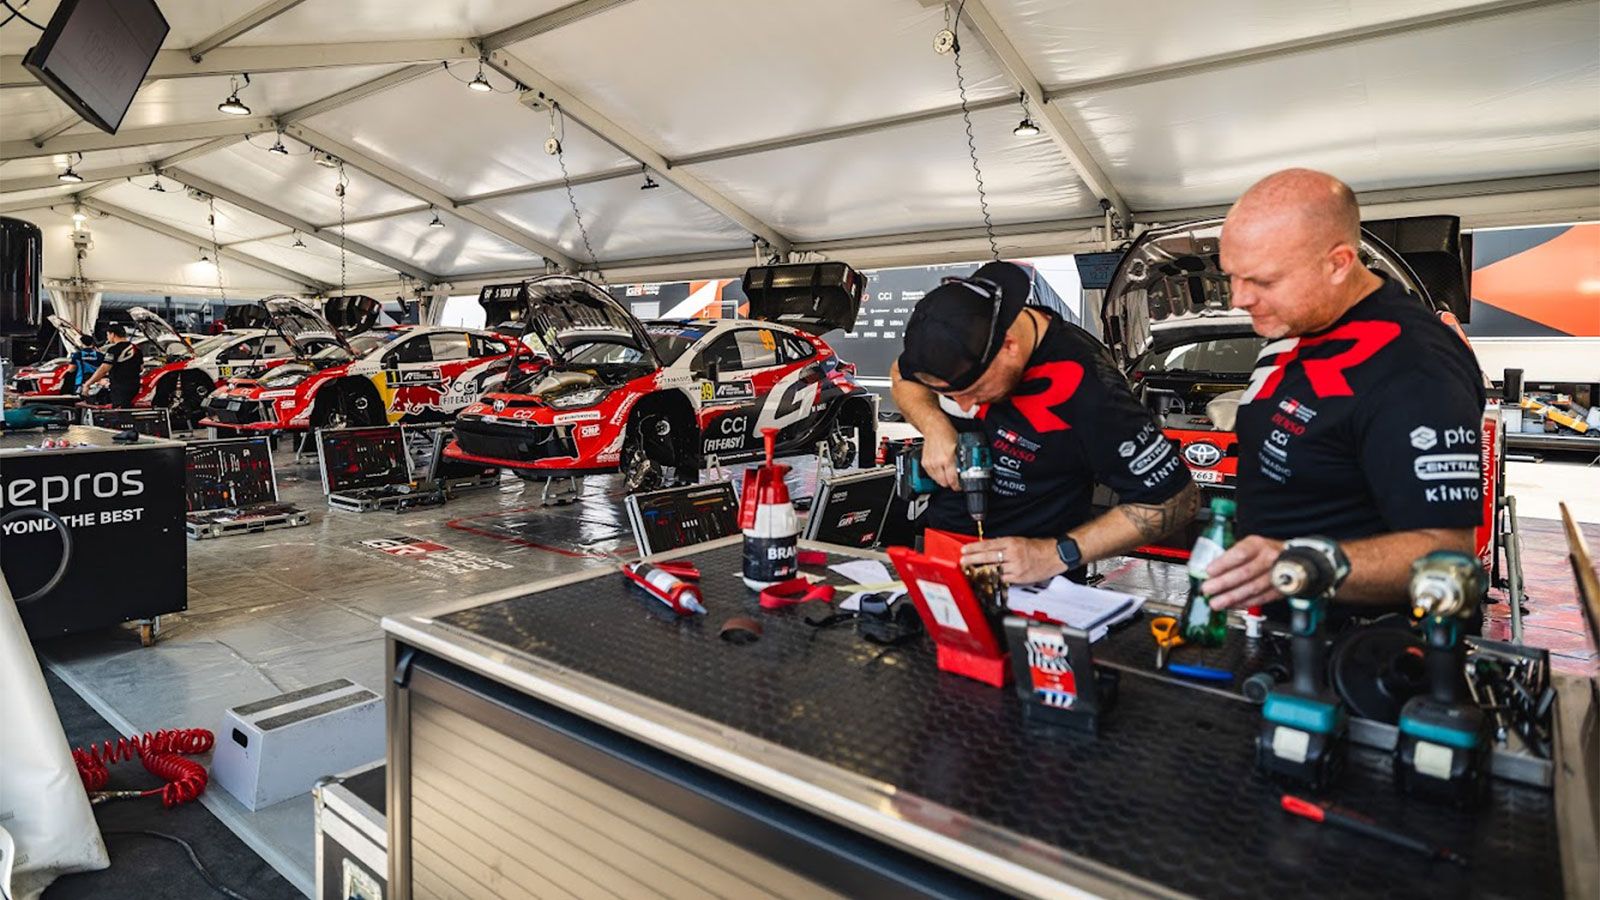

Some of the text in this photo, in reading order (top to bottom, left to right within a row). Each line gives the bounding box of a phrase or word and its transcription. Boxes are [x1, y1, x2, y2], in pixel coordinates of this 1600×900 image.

[758, 329, 776, 351] 99
[721, 416, 748, 434] CCi
[1136, 422, 1155, 445] ptc
[1271, 413, 1306, 436] DENSO
[1271, 429, 1290, 446] CCi
[1444, 426, 1476, 449] ptc
[994, 439, 1036, 462] DENSO
[999, 455, 1021, 469] CCi
[60, 512, 96, 528] THE
[100, 507, 144, 525] BEST
